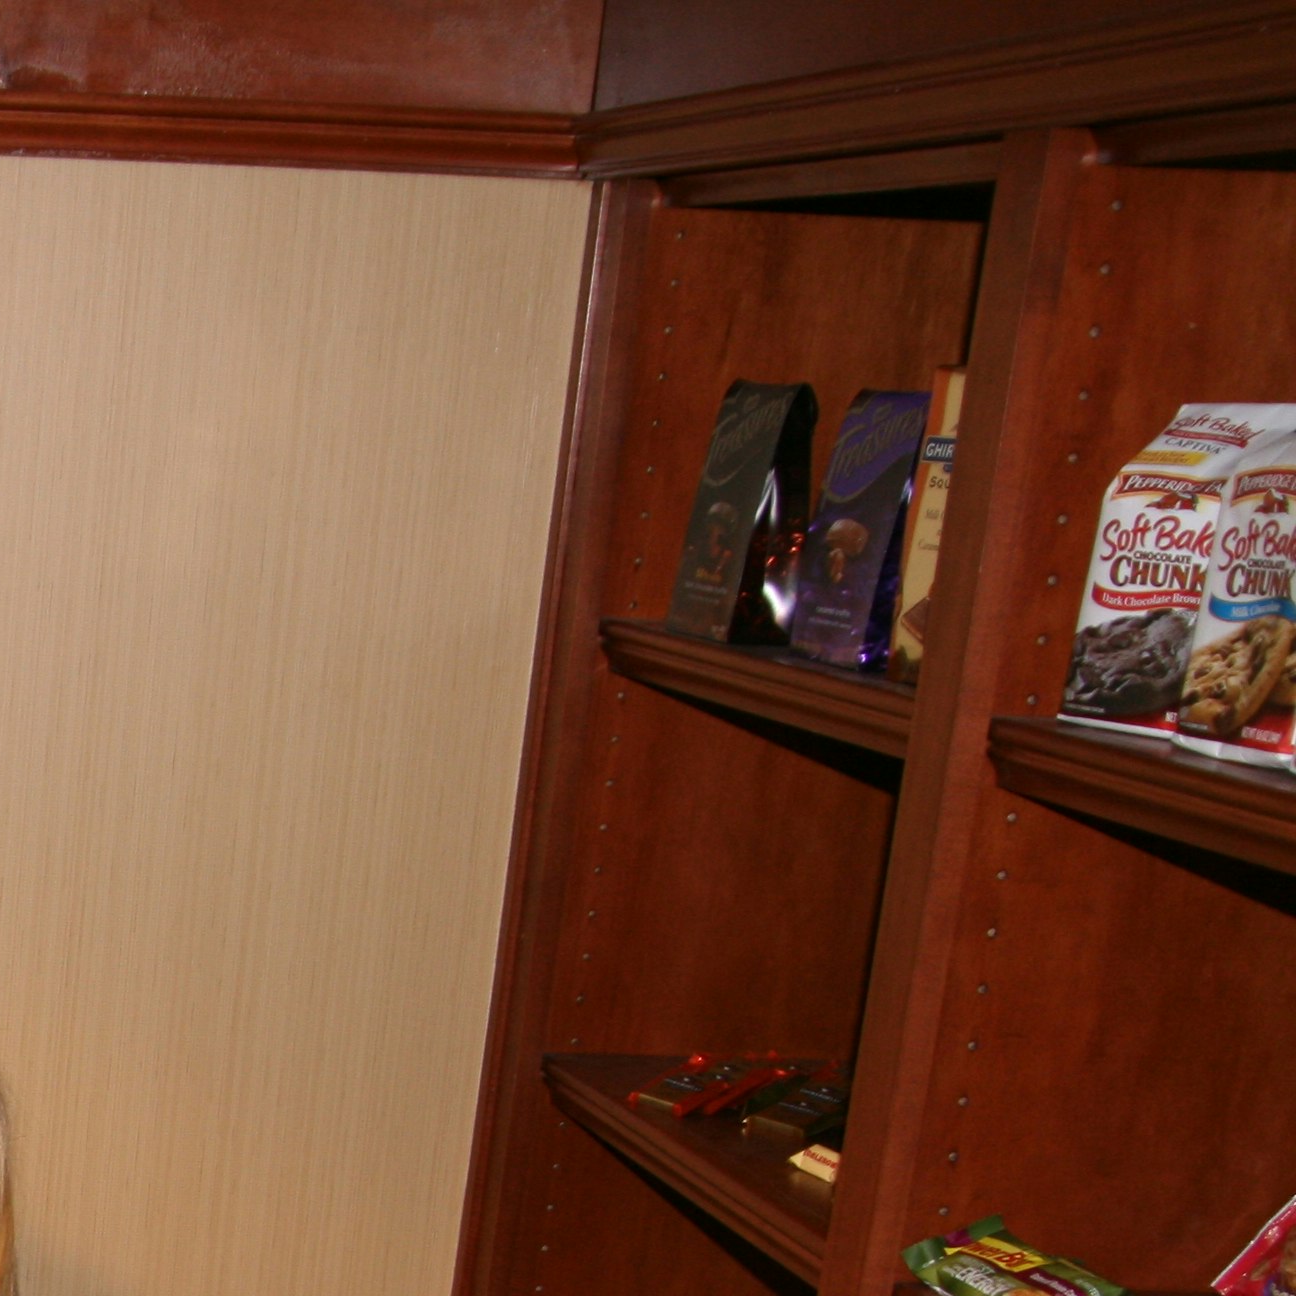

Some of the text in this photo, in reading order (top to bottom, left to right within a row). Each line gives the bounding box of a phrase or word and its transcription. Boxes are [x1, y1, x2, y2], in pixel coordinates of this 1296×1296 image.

[1100, 512, 1152, 561] Soft
[1218, 518, 1260, 571] Soft
[1133, 550, 1193, 564] CHOCOLATE
[1226, 562, 1295, 599] CHUNK
[1102, 592, 1122, 606] Dark
[1124, 594, 1172, 607] Chocolate
